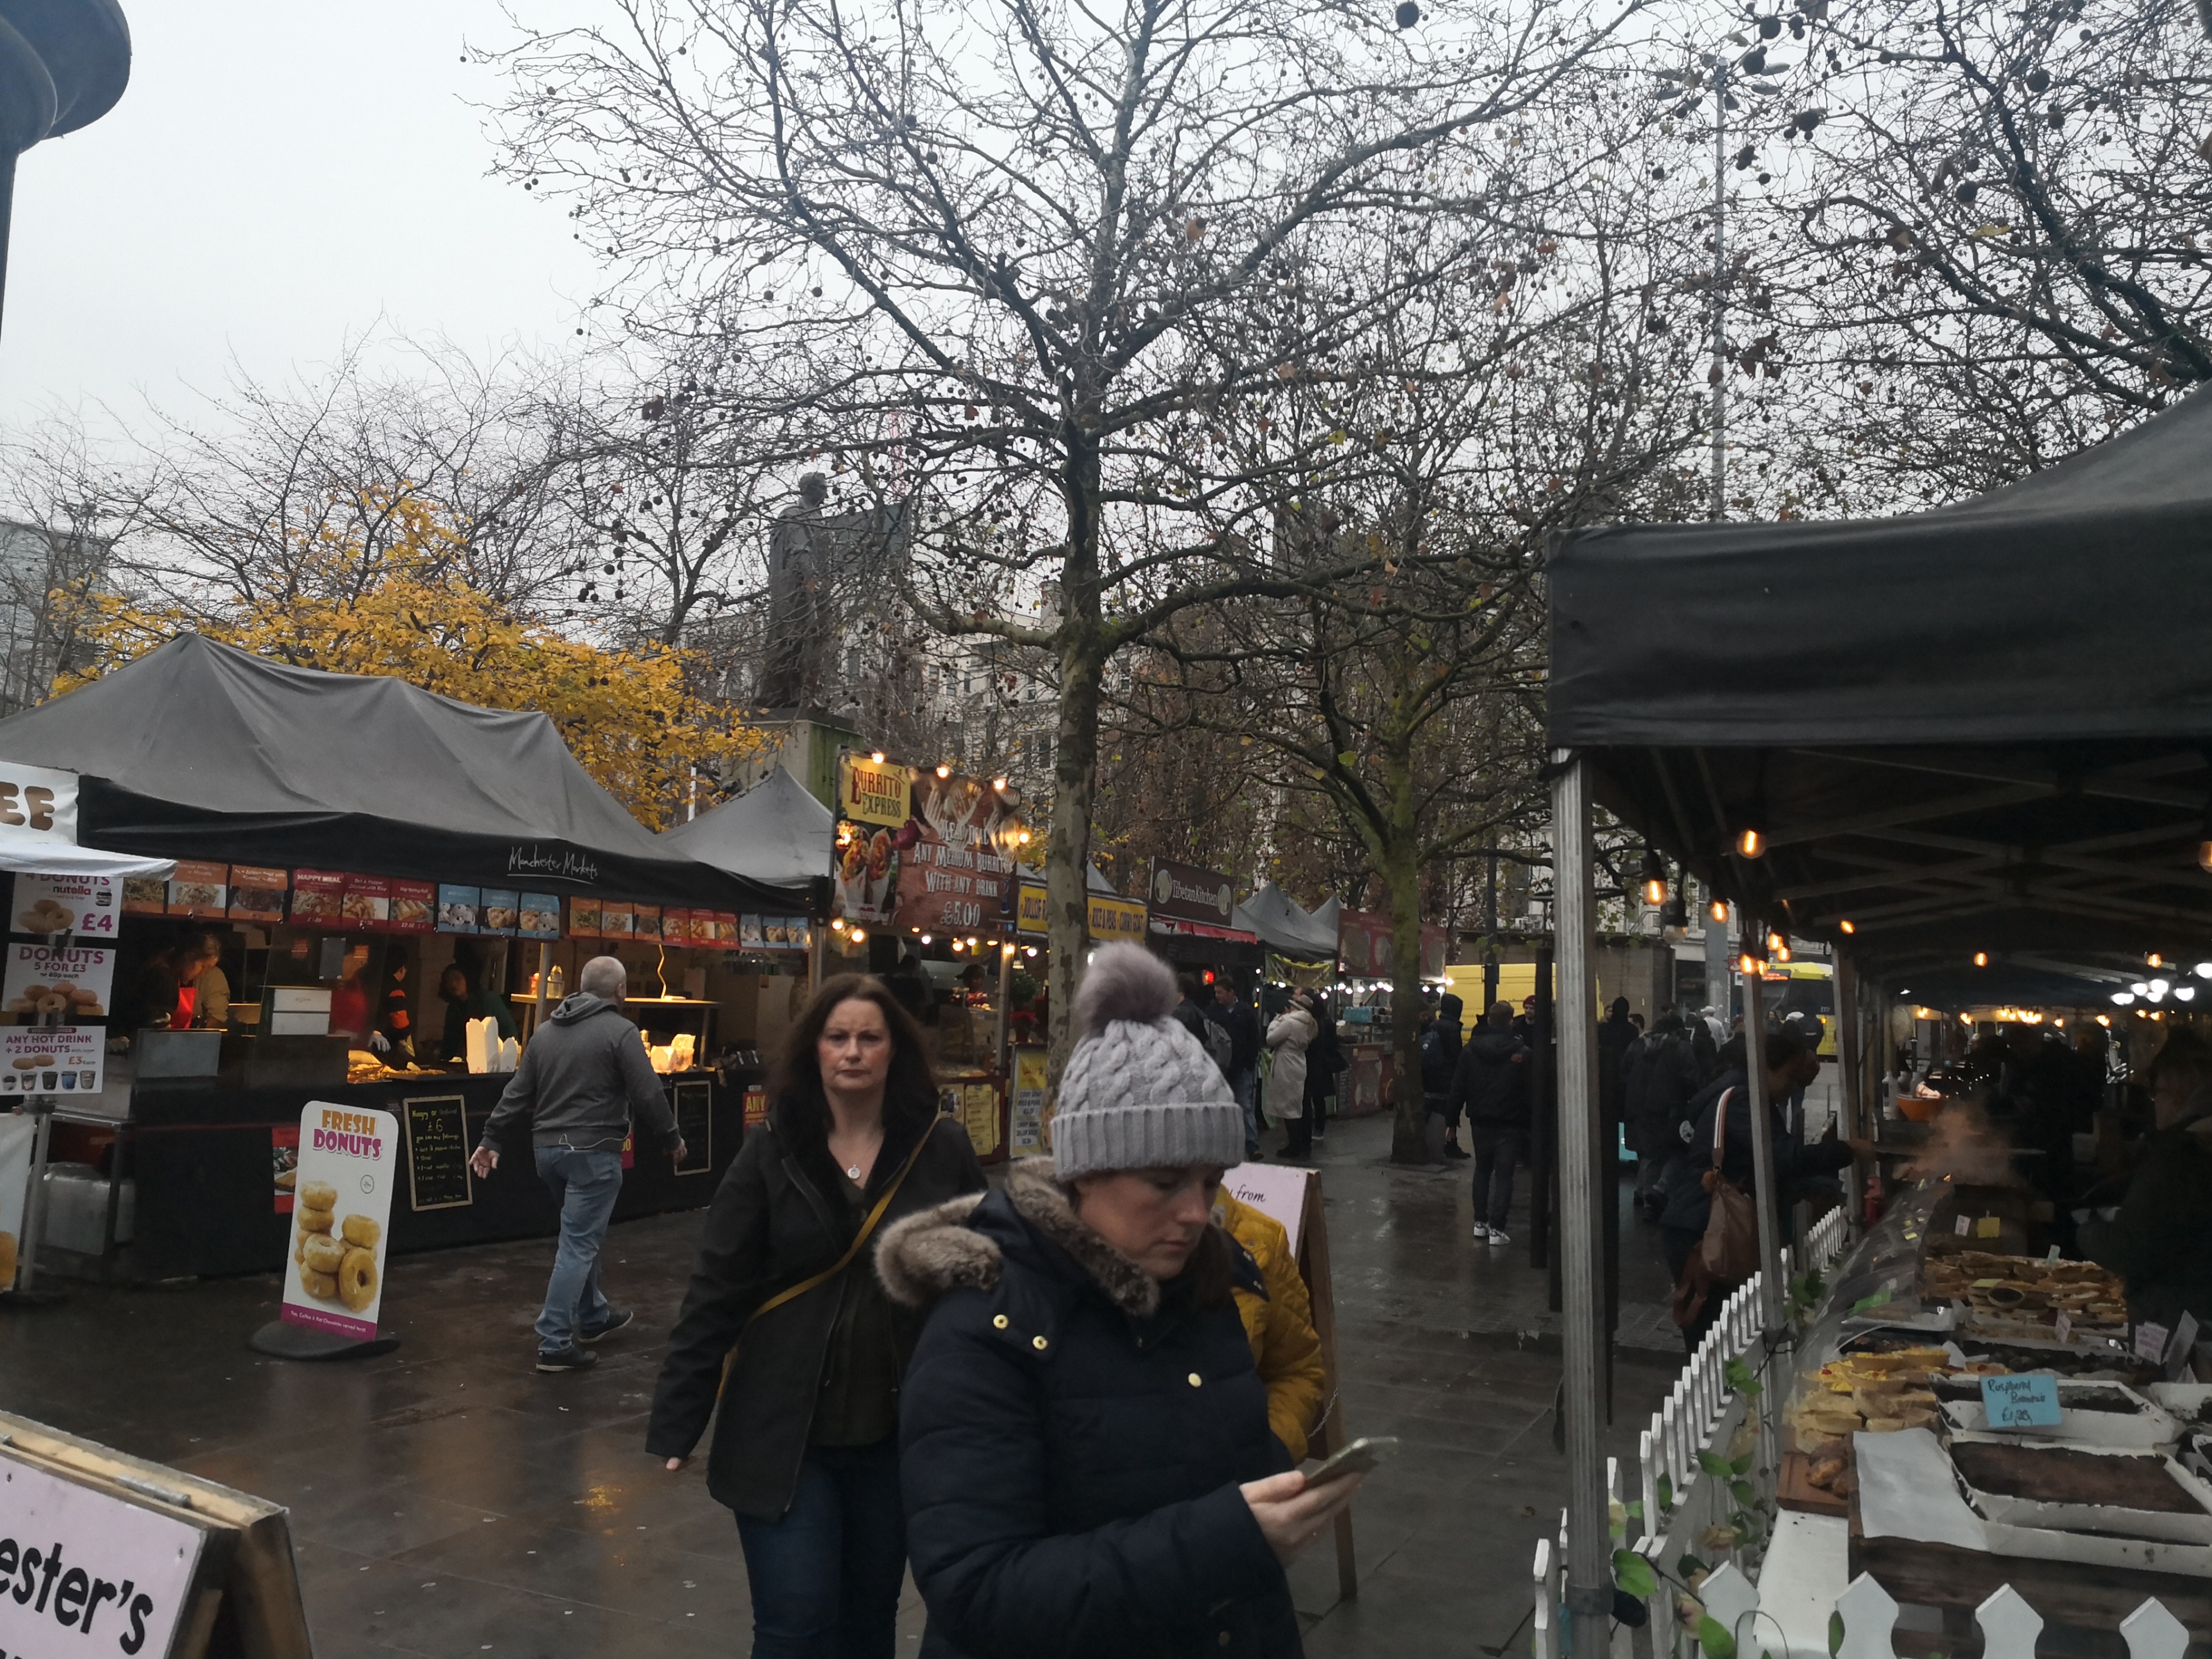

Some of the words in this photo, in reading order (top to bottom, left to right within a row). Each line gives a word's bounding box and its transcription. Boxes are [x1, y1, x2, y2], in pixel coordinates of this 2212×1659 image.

[851, 767, 902, 805] BURRITO
[863, 793, 901, 818] EXPRESS
[509, 844, 561, 871] Manchester
[563, 851, 598, 879] Markets
[53, 886, 91, 895] nutella
[925, 871, 952, 892] WITH
[954, 876, 972, 894] ANY
[976, 879, 999, 897] DRINK
[82, 914, 112, 932] £4
[939, 901, 981, 927] £5.00
[20, 947, 104, 964] DONUTS
[34, 962, 41, 970] 5
[45, 963, 69, 972] FOR
[72, 964, 86, 973] £3
[68, 1056, 82, 1065] £3
[745, 1095, 766, 1112] ANY
[322, 1109, 376, 1136] FRESH
[314, 1128, 382, 1158] DONUTS
[1236, 1184, 1266, 1203] from
